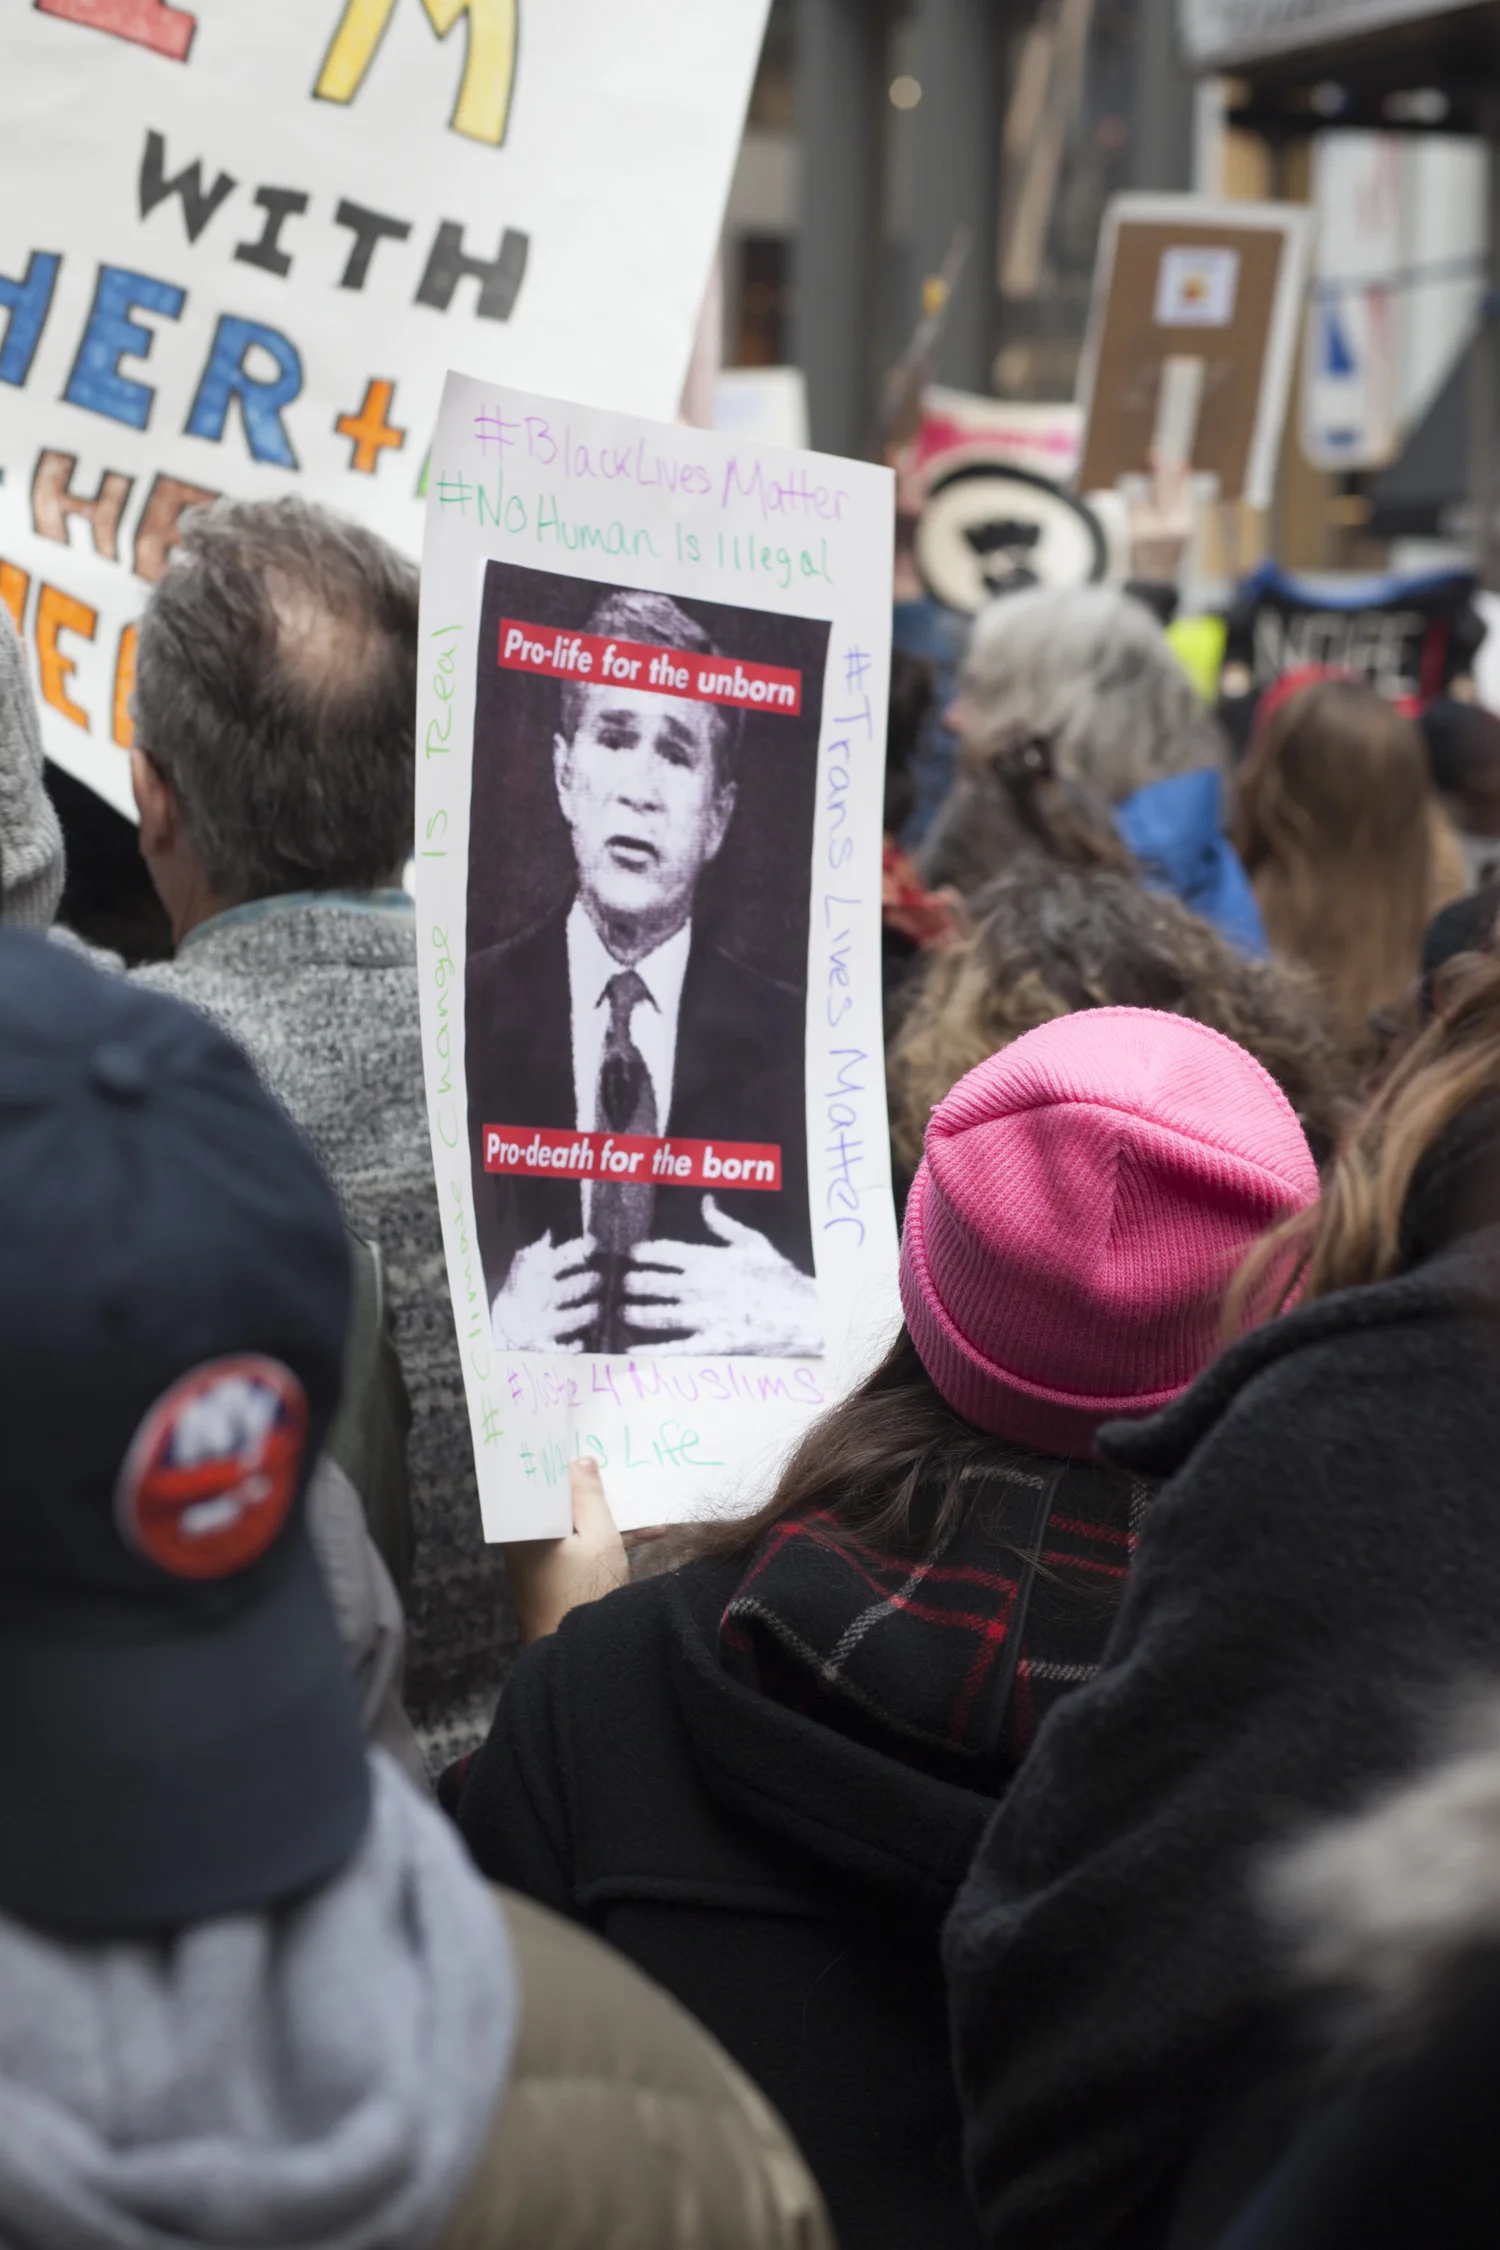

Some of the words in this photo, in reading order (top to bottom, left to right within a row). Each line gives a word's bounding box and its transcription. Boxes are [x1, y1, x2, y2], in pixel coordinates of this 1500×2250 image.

[137, 128, 531, 322] WITH
[677, 521, 702, 562] Is
[717, 531, 834, 588] Illegal
[425, 624, 464, 759] Real
[504, 628, 593, 675] Pro-life
[601, 644, 643, 682] for
[648, 652, 690, 690] the
[697, 665, 797, 708] unborn
[826, 643, 874, 870] #Trans
[823, 894, 863, 1028] Lives
[430, 924, 460, 1148] Change
[486, 1131, 595, 1174] Pro-death
[600, 1139, 645, 1176] for
[651, 1143, 693, 1177] the
[702, 1146, 776, 1183] born
[823, 1048, 869, 1247] Matter
[591, 1362, 622, 1408] 4
[628, 1360, 826, 1405] Muslims
[623, 1418, 727, 1469] Life
